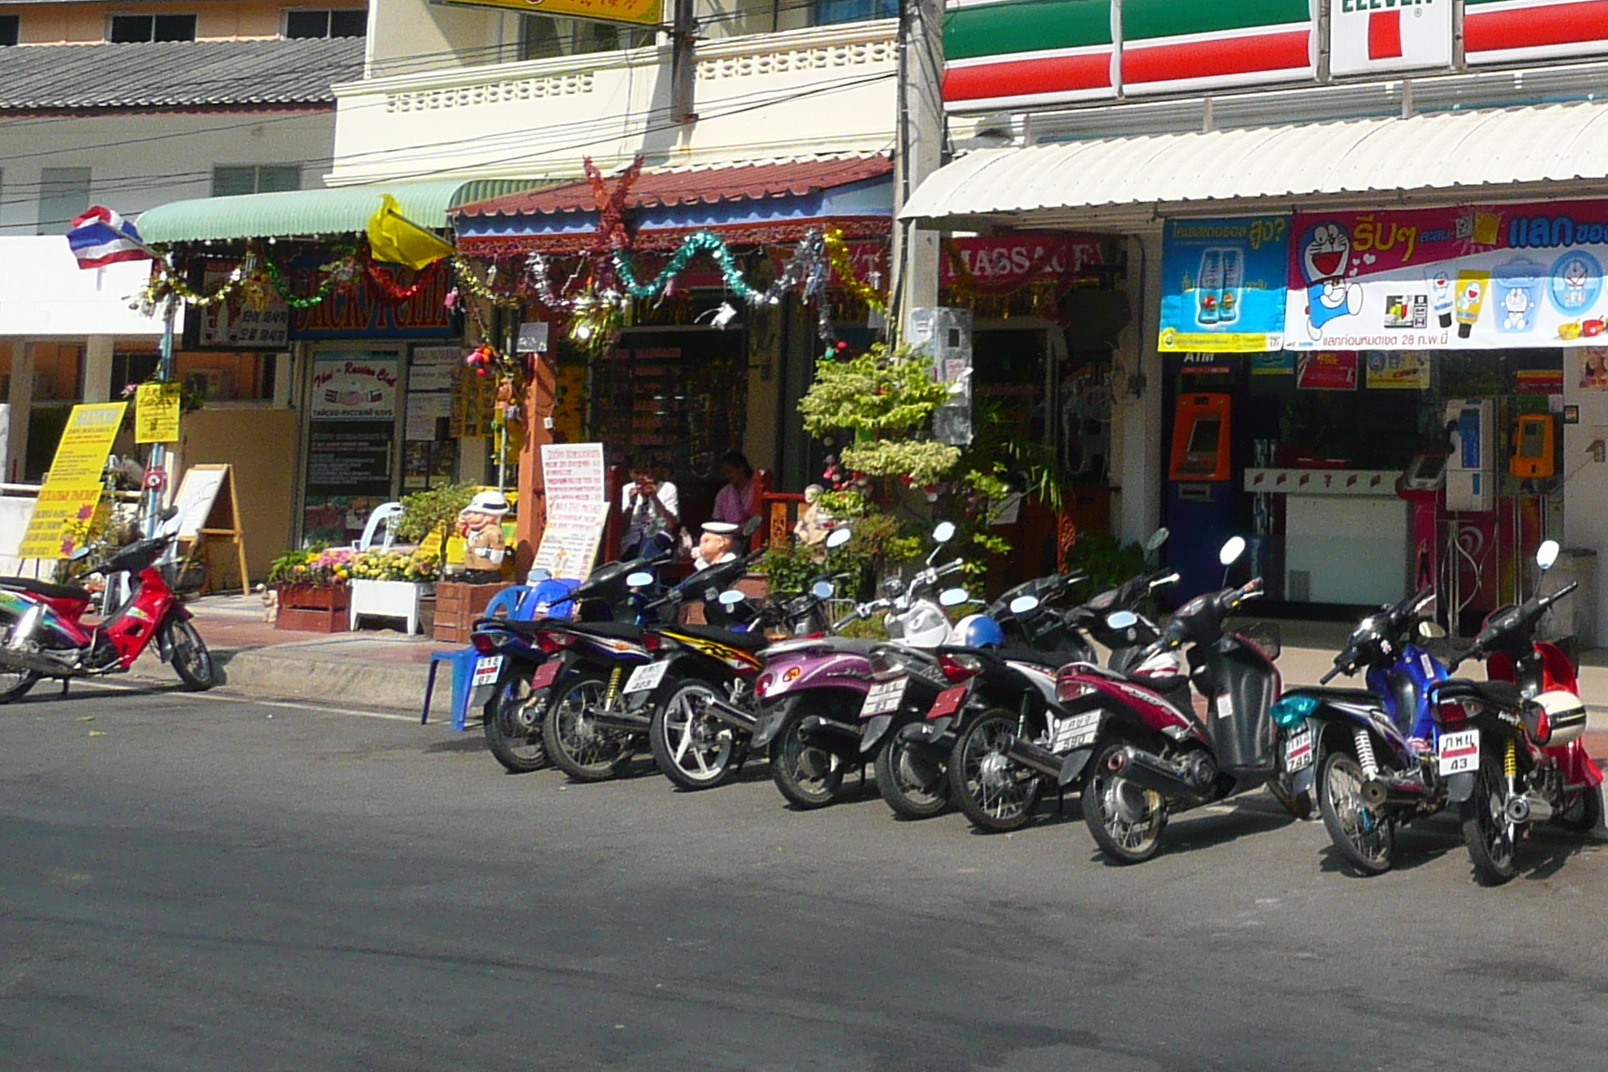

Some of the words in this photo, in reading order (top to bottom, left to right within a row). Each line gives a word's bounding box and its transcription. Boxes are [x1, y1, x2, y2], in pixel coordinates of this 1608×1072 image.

[1353, 215, 1416, 262] รีบๆ
[1402, 334, 1414, 346] 28
[1450, 758, 1467, 770] 43
